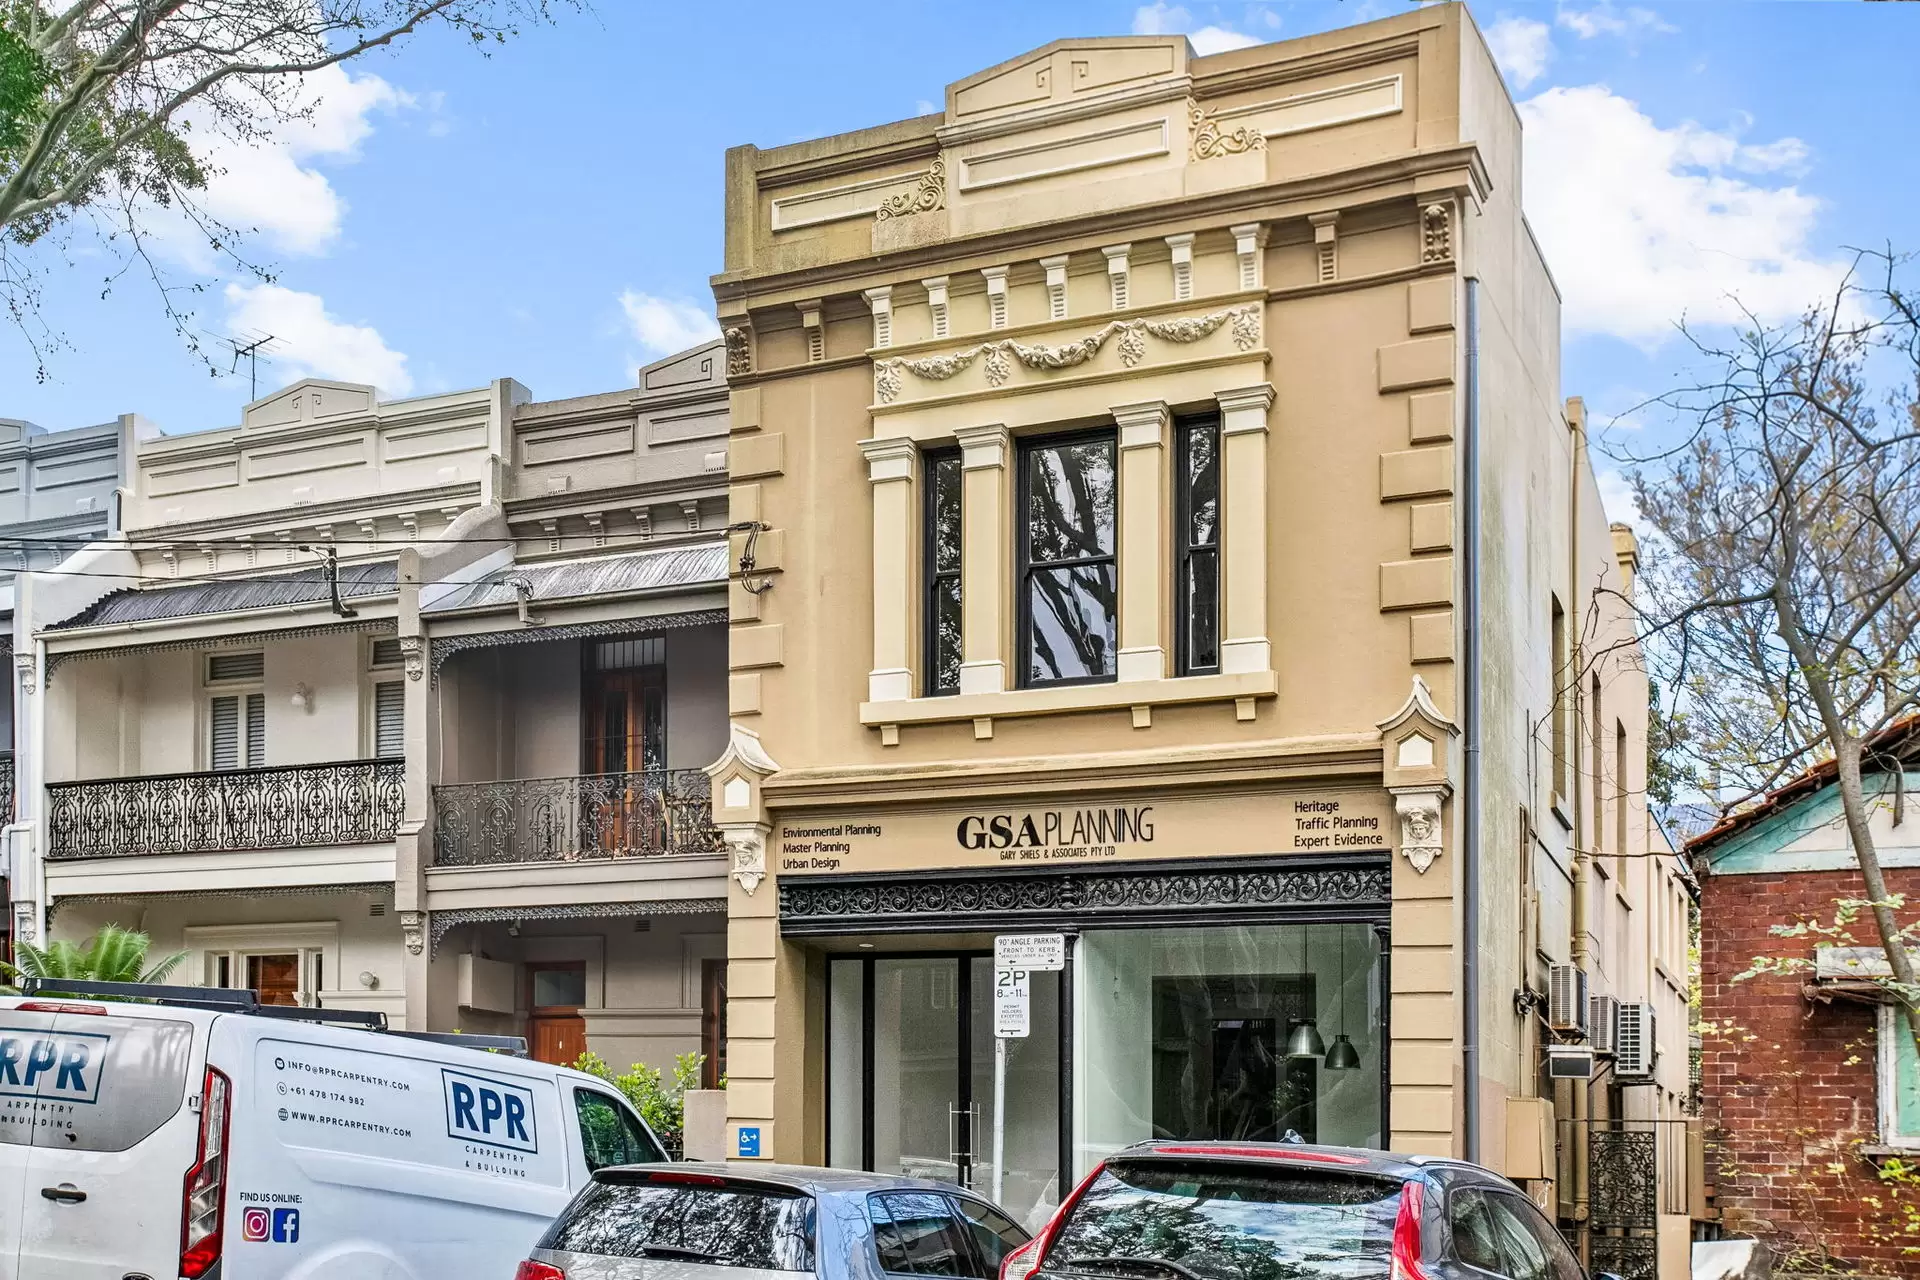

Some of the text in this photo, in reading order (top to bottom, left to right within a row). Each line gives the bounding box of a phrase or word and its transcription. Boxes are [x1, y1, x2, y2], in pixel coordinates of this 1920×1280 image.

[1294, 801, 1339, 814] Heritage
[783, 824, 882, 838] Environmental Planning
[957, 807, 1154, 849] GSA PLANNING
[1295, 816, 1378, 830] Traffic Planning
[783, 841, 850, 854] Master Planning
[1294, 833, 1383, 850] Expert Evidence
[1000, 845, 1116, 861] GARY SHIELS & ASSOCIATES PTY LTD
[783, 857, 840, 870] Urban Design
[1011, 937, 1031, 946] ANGLE
[1033, 936, 1061, 945] PARKING
[998, 970, 1026, 987] 2P
[288, 1060, 410, 1091] INFO@RPRCARPENTRY.COM
[290, 1087, 365, 1106] +61 478 174 982
[451, 1080, 530, 1142] RPR
[291, 1111, 412, 1137] WWW.RPRCARPENTRY.COM
[465, 1145, 525, 1163] CARPENTRY
[465, 1160, 526, 1178] & BUILDING
[240, 1192, 303, 1204] FIND US ONLINE:
